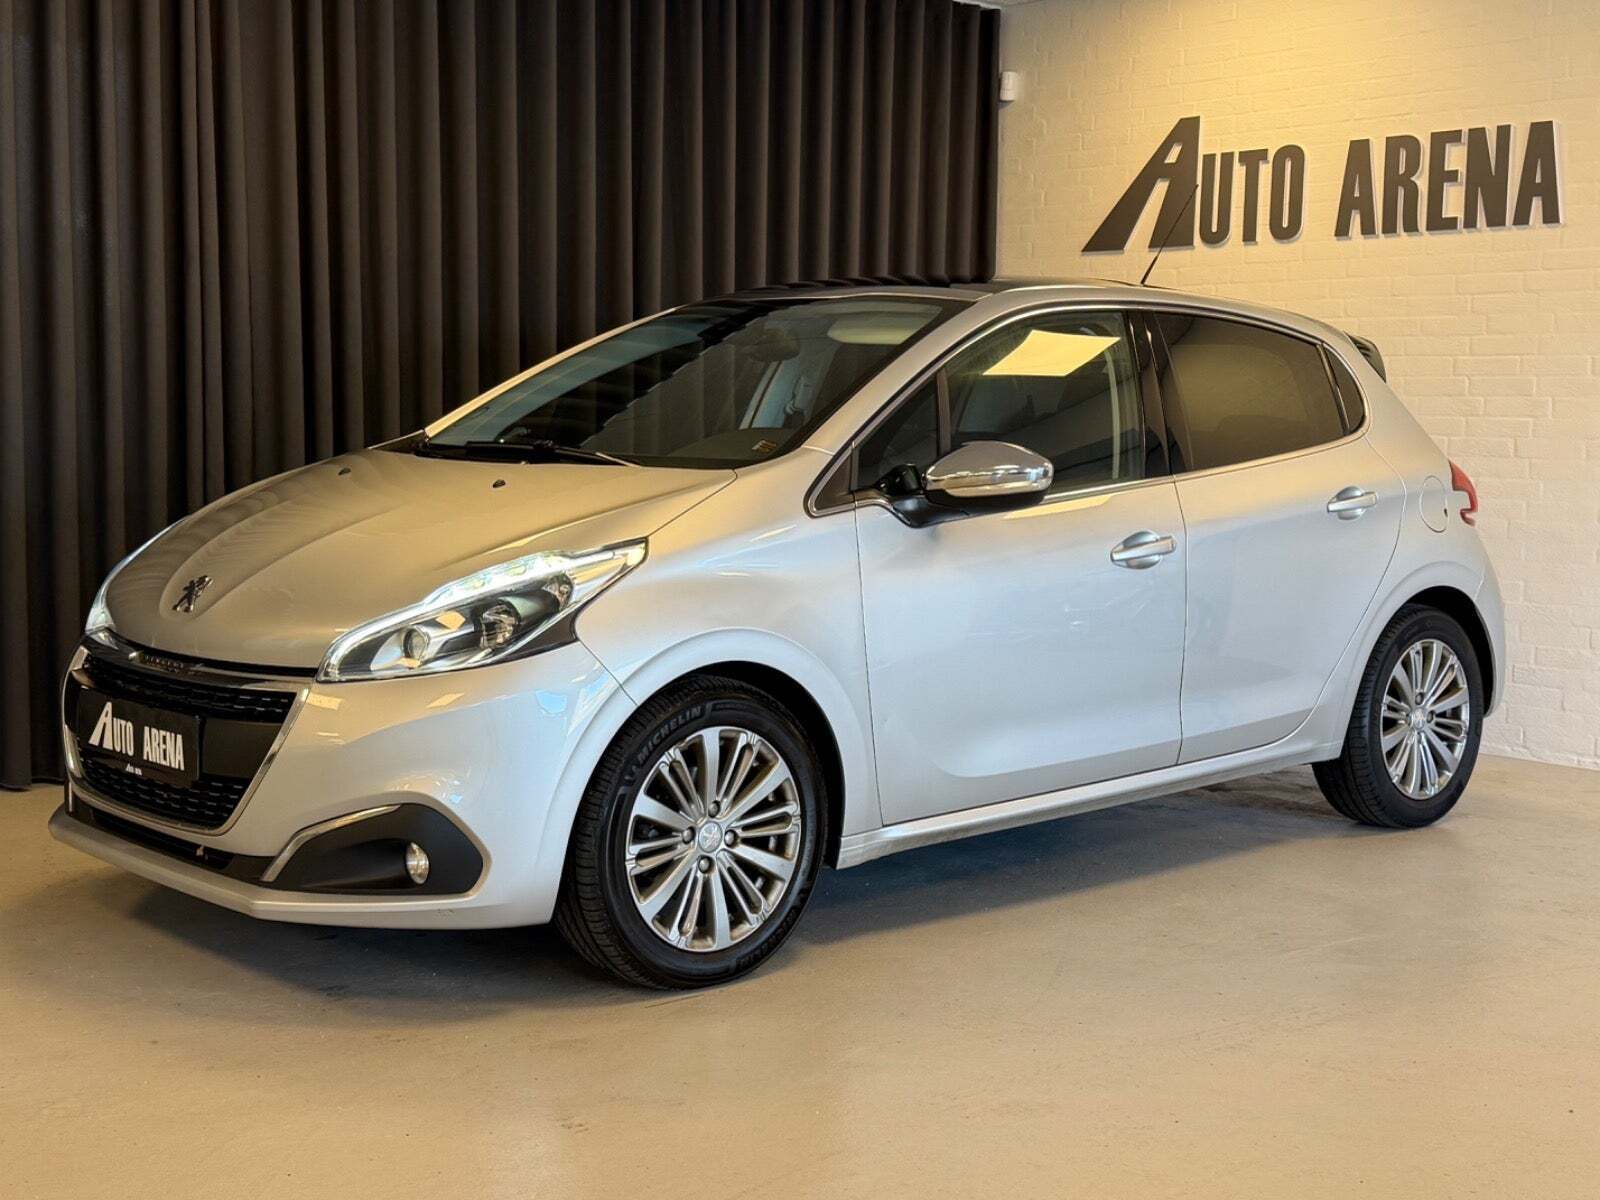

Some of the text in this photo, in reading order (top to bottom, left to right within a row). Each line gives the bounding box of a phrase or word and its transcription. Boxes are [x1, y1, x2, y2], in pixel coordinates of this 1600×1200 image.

[1081, 115, 1563, 253] AUTO ARENA
[89, 702, 185, 771] AUTO ARENA
[637, 705, 702, 764] MICHELIN
